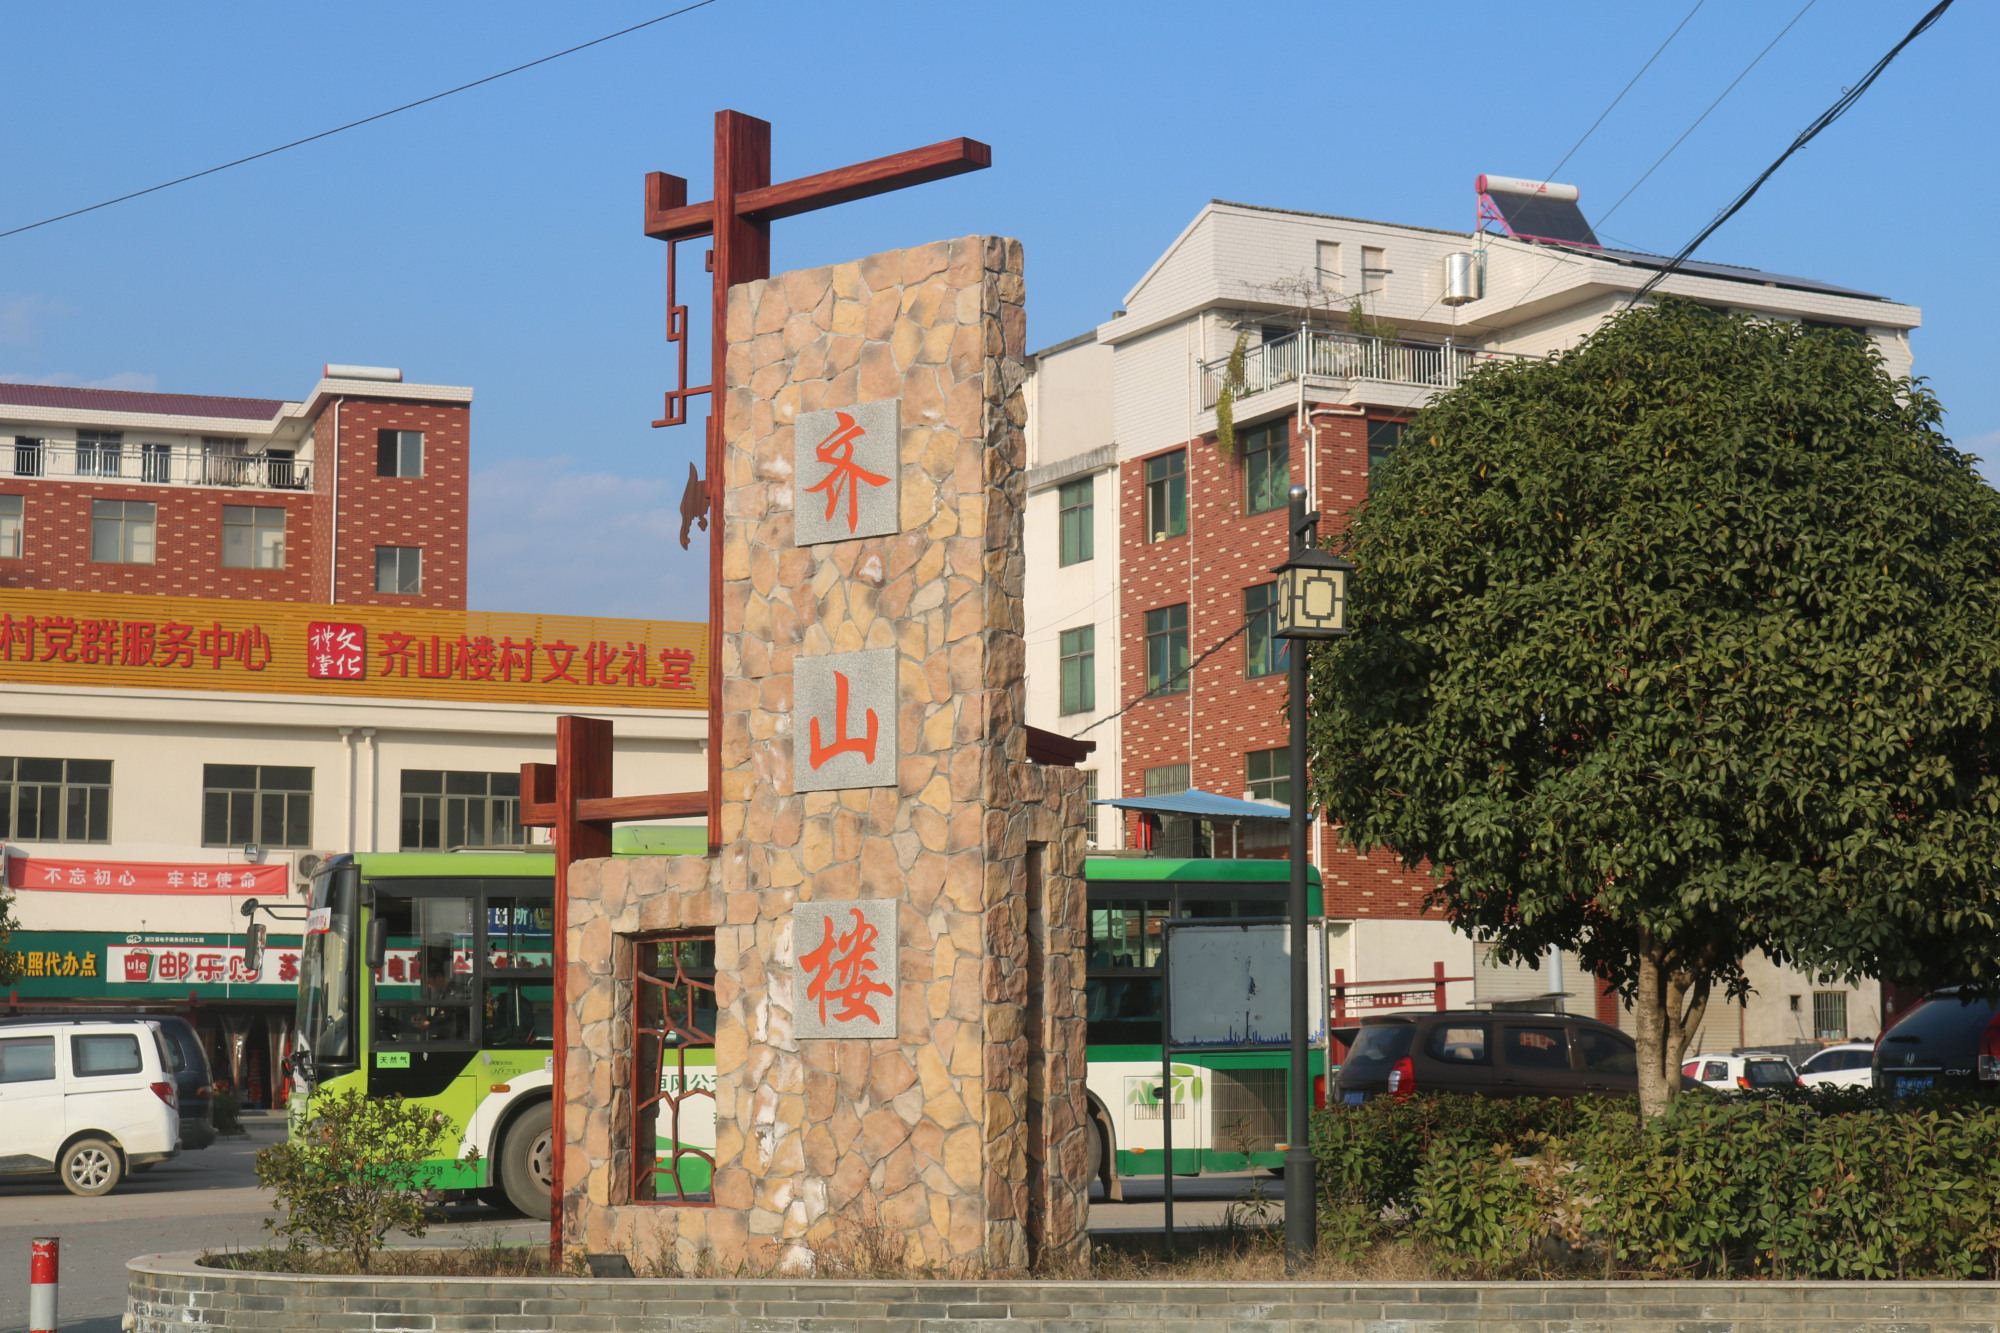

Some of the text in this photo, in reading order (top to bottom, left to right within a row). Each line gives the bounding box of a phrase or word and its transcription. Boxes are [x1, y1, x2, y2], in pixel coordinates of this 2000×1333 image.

[0, 613, 271, 671] 村党群服务中心
[377, 631, 695, 690] 齐山楼村文化礼堂
[44, 867, 257, 889] 不忘初心 牢记使命
[127, 959, 147, 970] ule
[158, 950, 299, 983] 邮乐购 苏
[380, 1055, 408, 1064] 天然气
